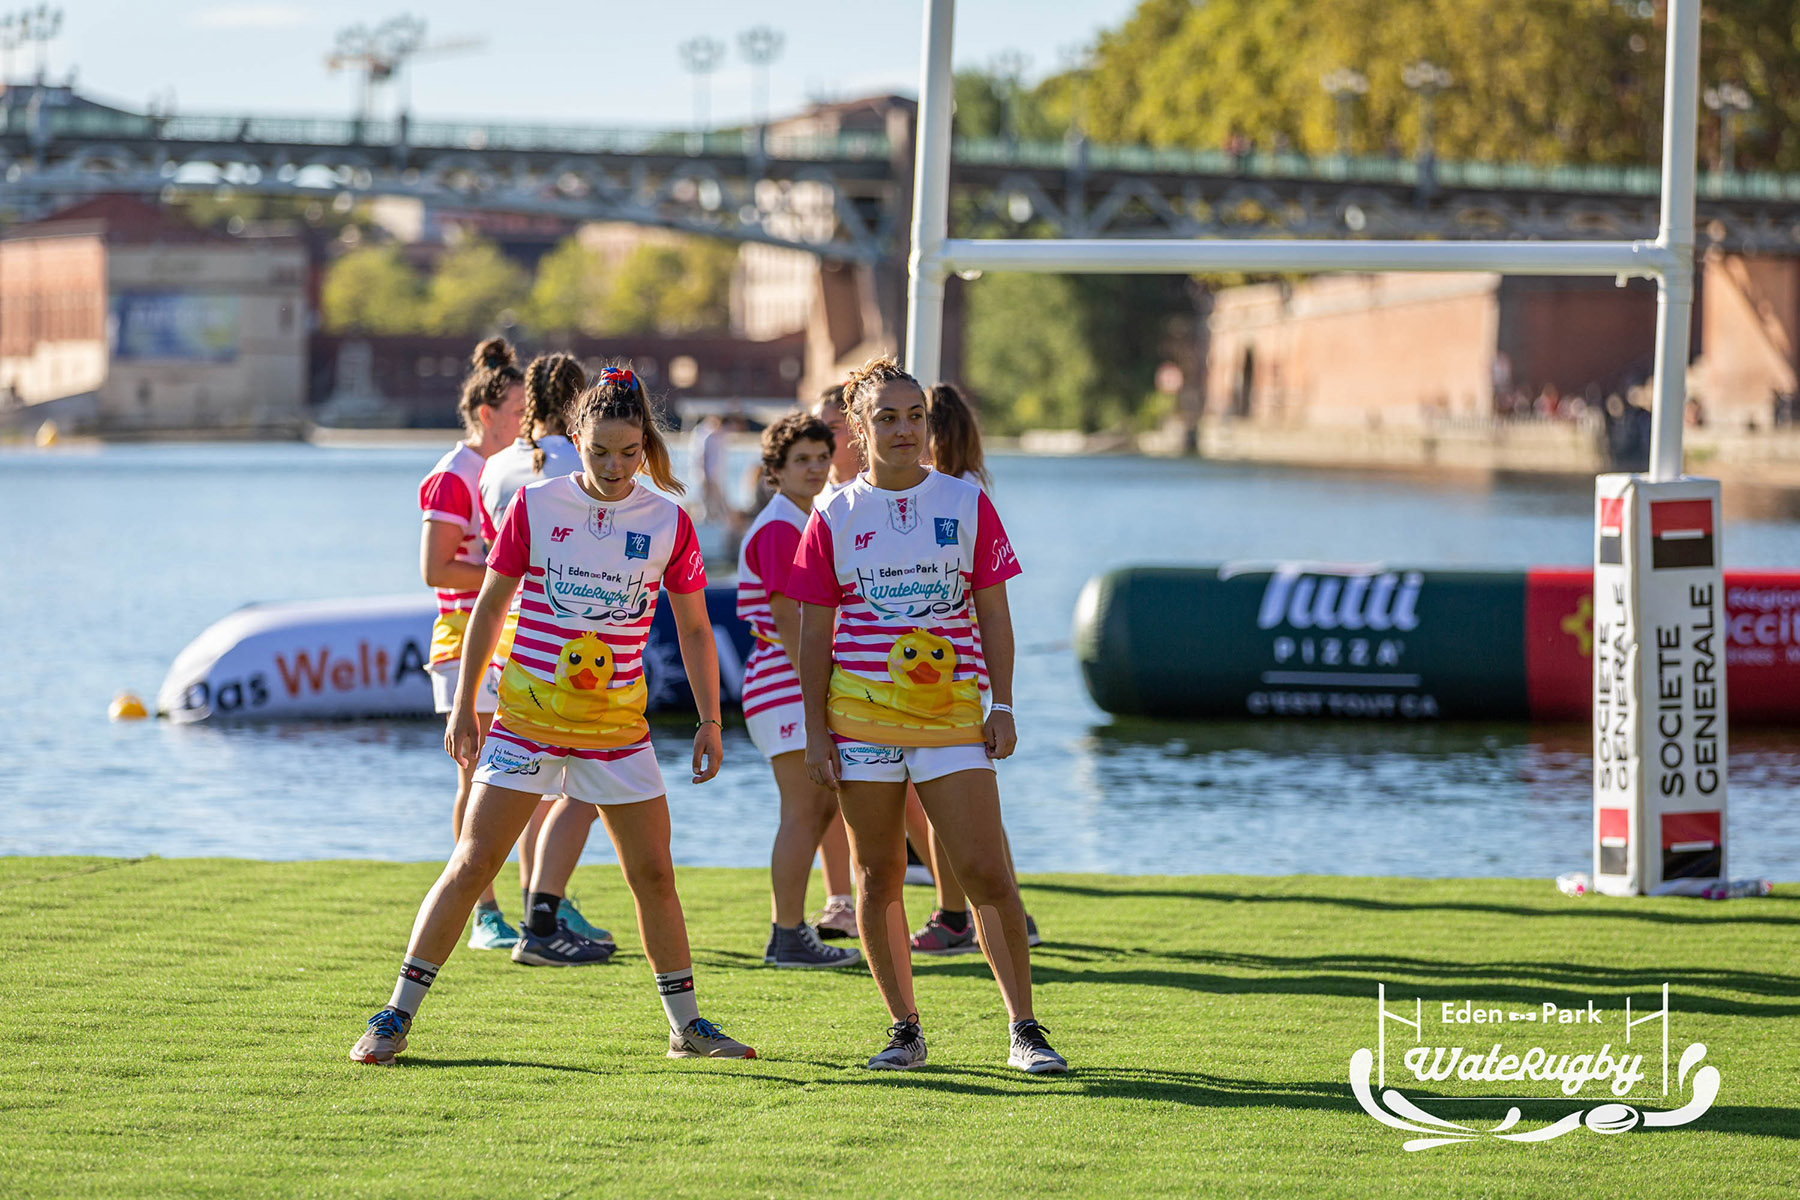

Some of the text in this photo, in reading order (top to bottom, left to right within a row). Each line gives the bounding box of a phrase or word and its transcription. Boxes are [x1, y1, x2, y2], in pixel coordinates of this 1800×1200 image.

[550, 526, 574, 542] MF
[855, 531, 876, 549] MF
[568, 566, 622, 583] Eden Park
[879, 563, 938, 578] Eden Park
[554, 581, 631, 607] WateRugby
[870, 579, 950, 600] WateRugby
[1217, 560, 1426, 631] Tutti
[1273, 636, 1400, 666] PIZZA
[184, 671, 269, 711] Das
[1613, 583, 1629, 790] GENERALE
[1690, 583, 1719, 796] GENERALE
[1598, 623, 1612, 790] SOCIETE
[1657, 624, 1685, 797] SOCIETE
